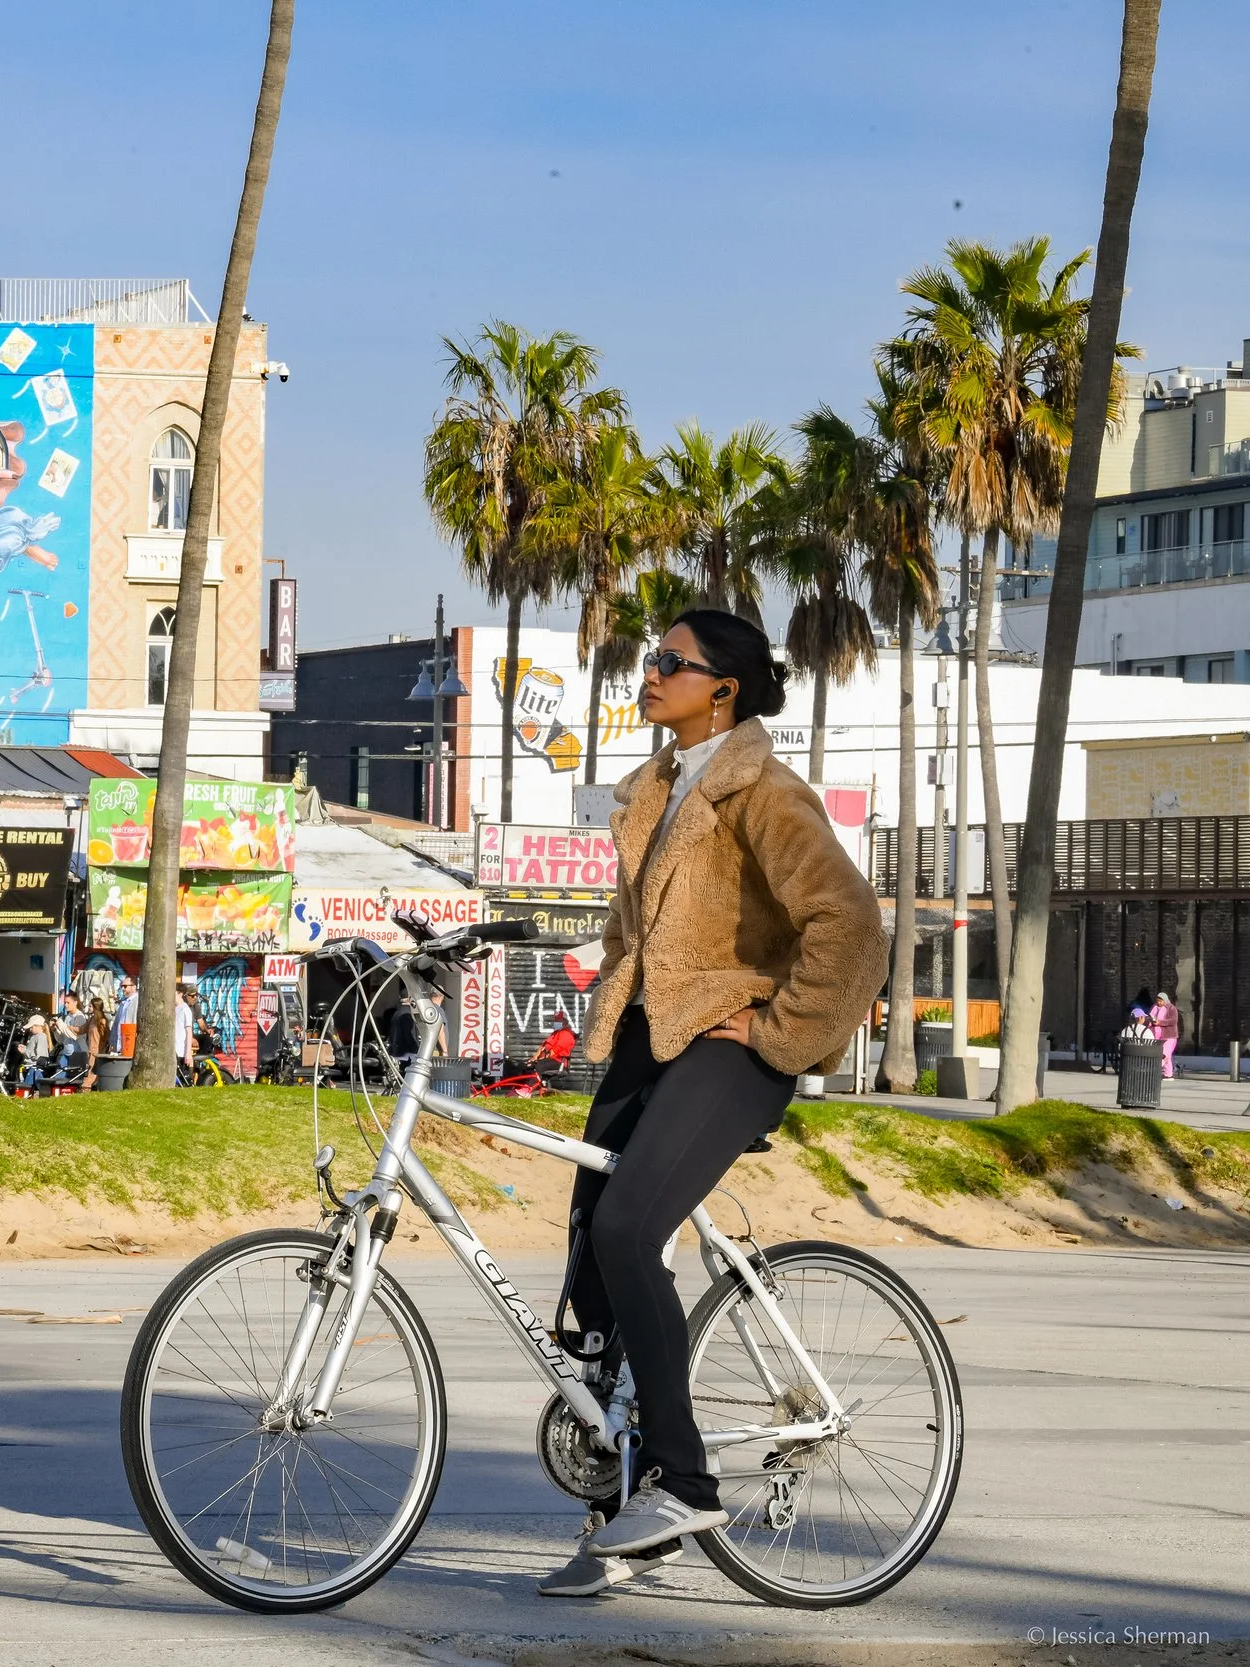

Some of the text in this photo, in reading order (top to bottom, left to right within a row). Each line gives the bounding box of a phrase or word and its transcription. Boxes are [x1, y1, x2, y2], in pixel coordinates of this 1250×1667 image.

[279, 585, 292, 666] BAR
[518, 685, 558, 714] Lite
[605, 684, 633, 700] IT'S
[223, 785, 258, 804] FRUIT
[6, 831, 64, 845] RENTAL
[484, 826, 498, 851] 2
[523, 835, 618, 859] HENN
[480, 854, 500, 864] FOR
[16, 872, 50, 888] BUY
[479, 866, 501, 881] $10
[321, 897, 386, 922] VENICE
[327, 928, 354, 941] BODY
[356, 928, 399, 945] Massage
[266, 958, 297, 977] ATM
[532, 951, 546, 988] I
[259, 995, 277, 1011] ATM
[489, 949, 503, 1072] MASSAGE
[474, 1249, 583, 1384] GIANT
